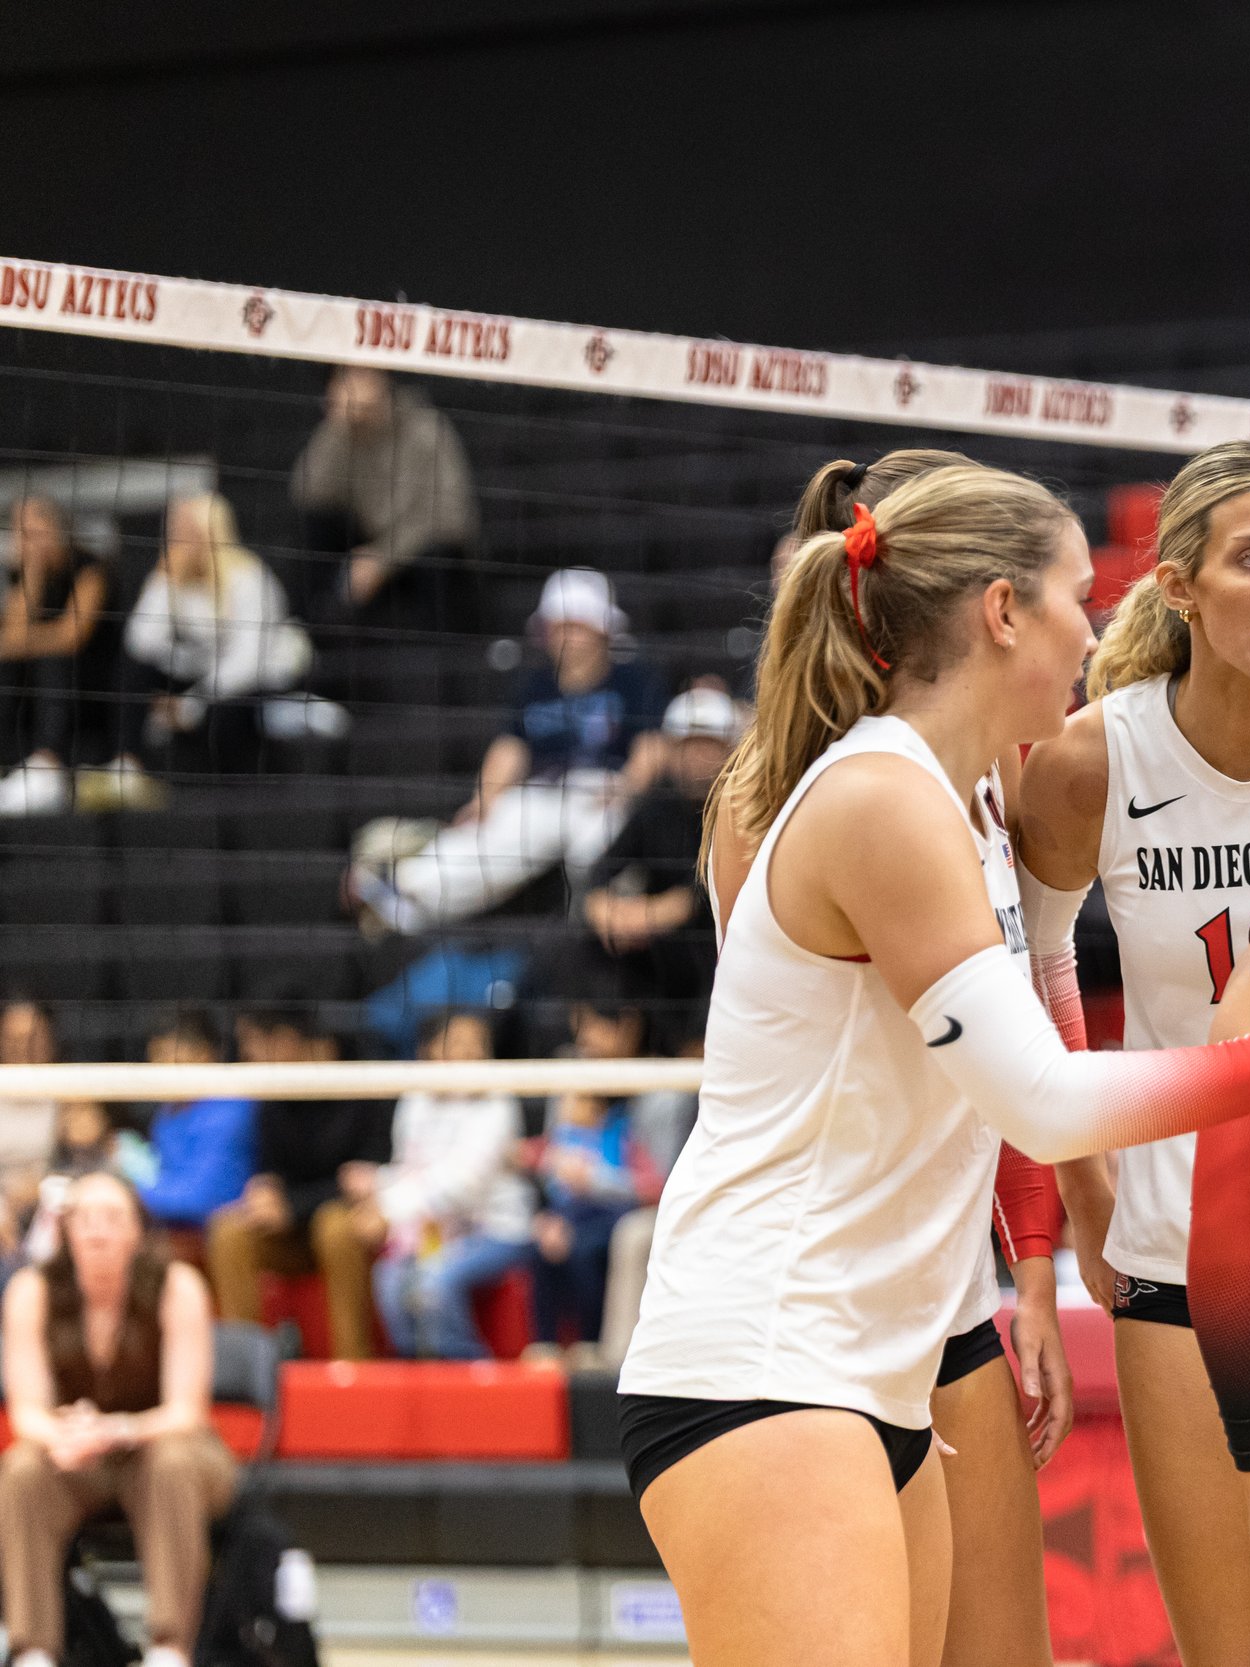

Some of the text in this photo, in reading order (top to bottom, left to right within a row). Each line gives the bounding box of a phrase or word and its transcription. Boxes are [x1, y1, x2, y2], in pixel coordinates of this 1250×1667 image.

[59, 272, 158, 323] AZTECS
[354, 307, 512, 361] SDSU AZTECS
[1136, 846, 1184, 893] SAN
